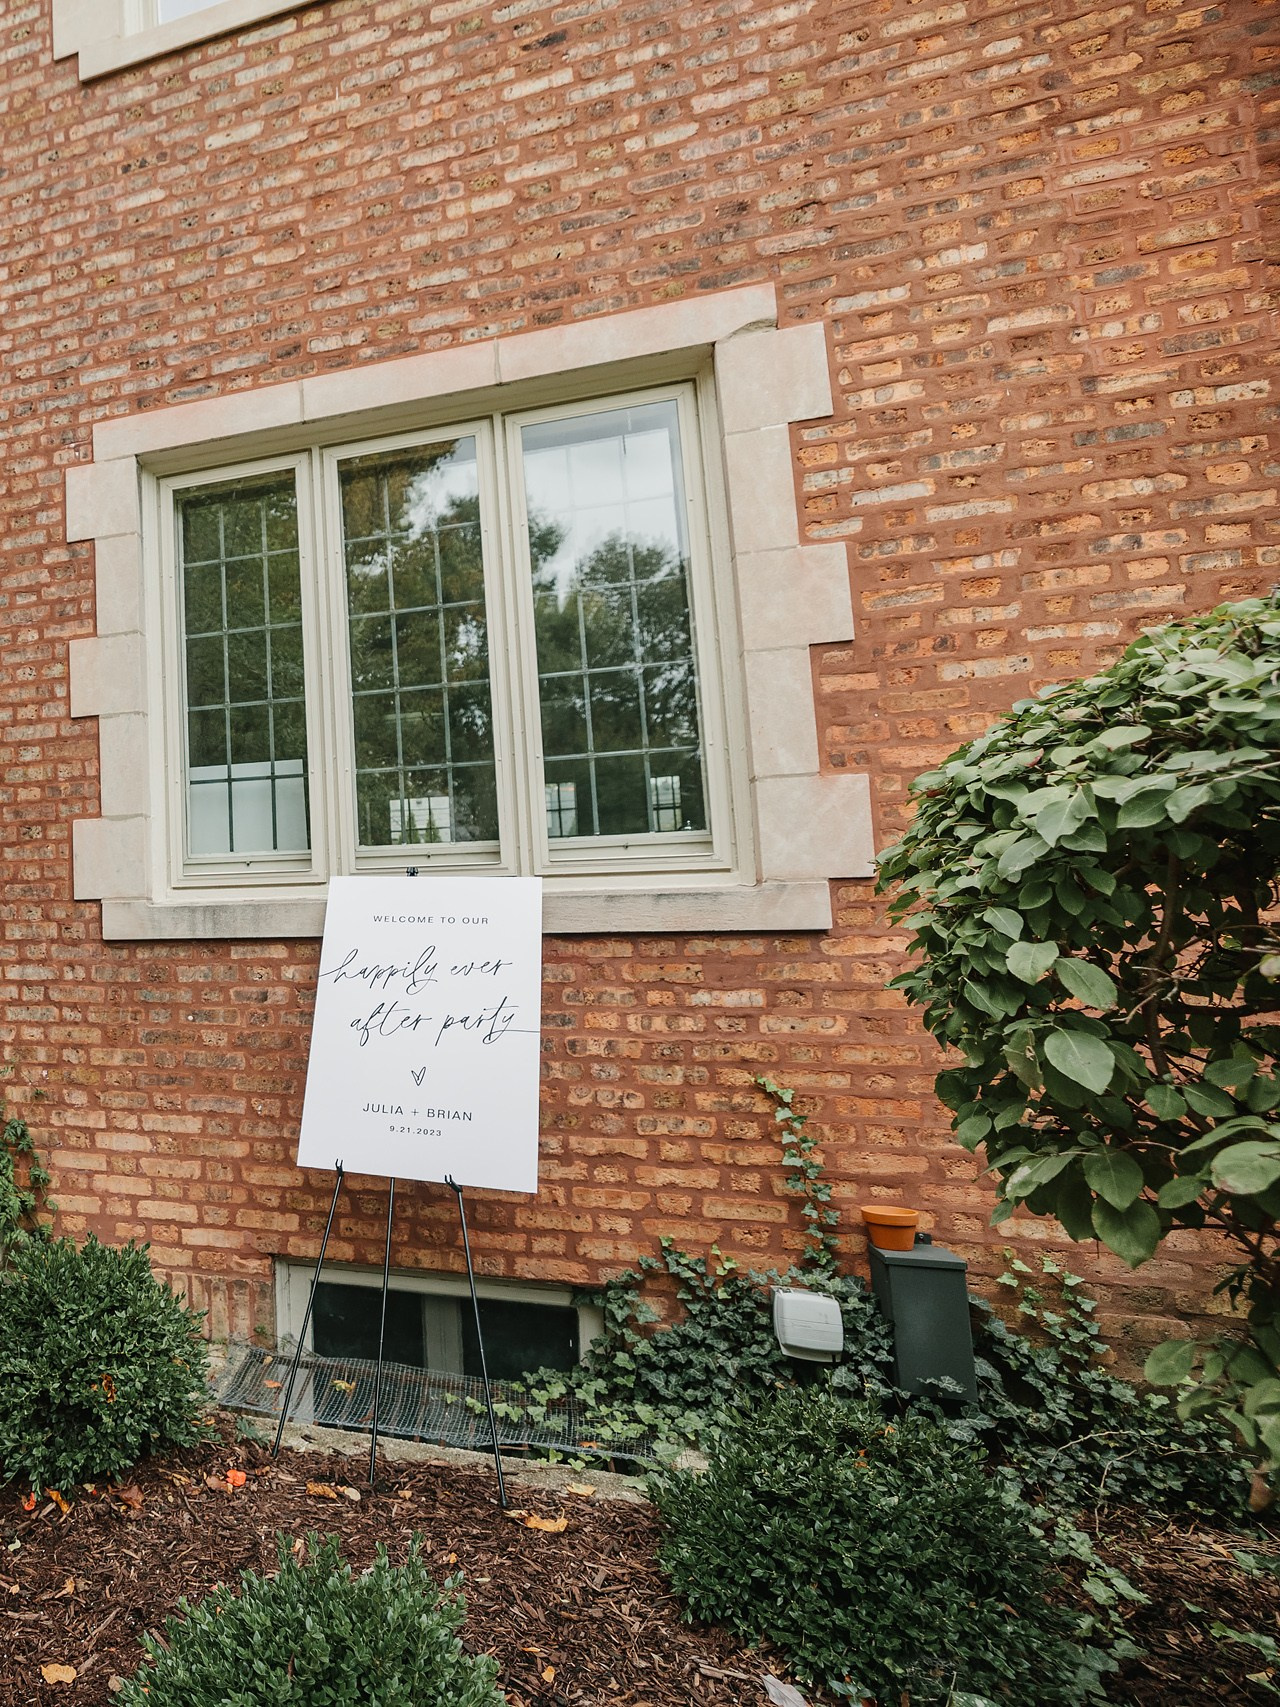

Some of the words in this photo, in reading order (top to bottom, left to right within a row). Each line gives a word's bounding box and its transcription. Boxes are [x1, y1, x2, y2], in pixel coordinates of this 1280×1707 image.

[373, 915, 434, 924] WELCOME
[440, 916, 456, 925] TO
[461, 916, 489, 925] OUR
[320, 944, 439, 996] happily
[450, 959, 514, 977] ever
[349, 1000, 433, 1048] after
[434, 995, 540, 1047] party
[362, 1102, 404, 1116] JULIA
[426, 1108, 473, 1122] BRIAN
[389, 1125, 442, 1137] 9.21.2023
